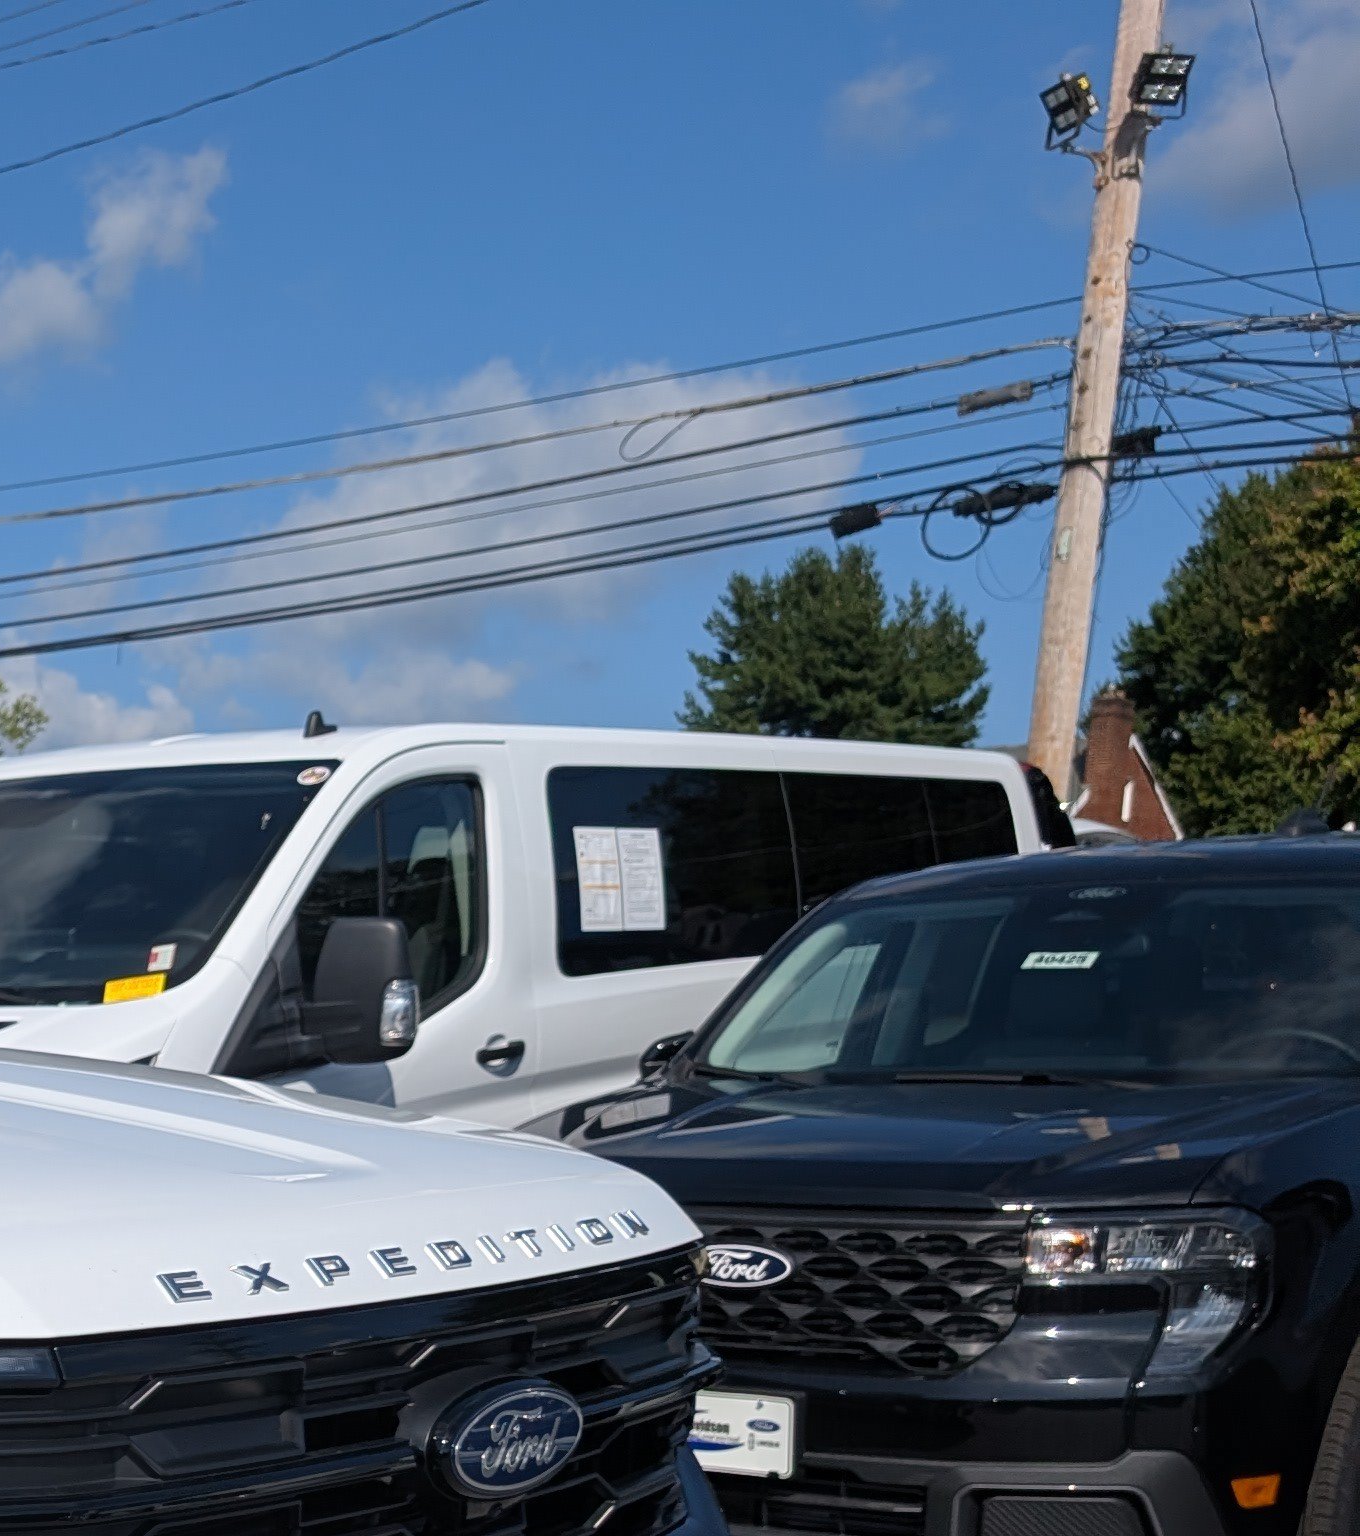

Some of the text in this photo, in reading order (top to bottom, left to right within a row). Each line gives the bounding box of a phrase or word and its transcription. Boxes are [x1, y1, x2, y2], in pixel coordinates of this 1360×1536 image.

[155, 1208, 650, 1304] EXPEDITION
[707, 1249, 770, 1281] Ford
[481, 1406, 561, 1478] Ford
